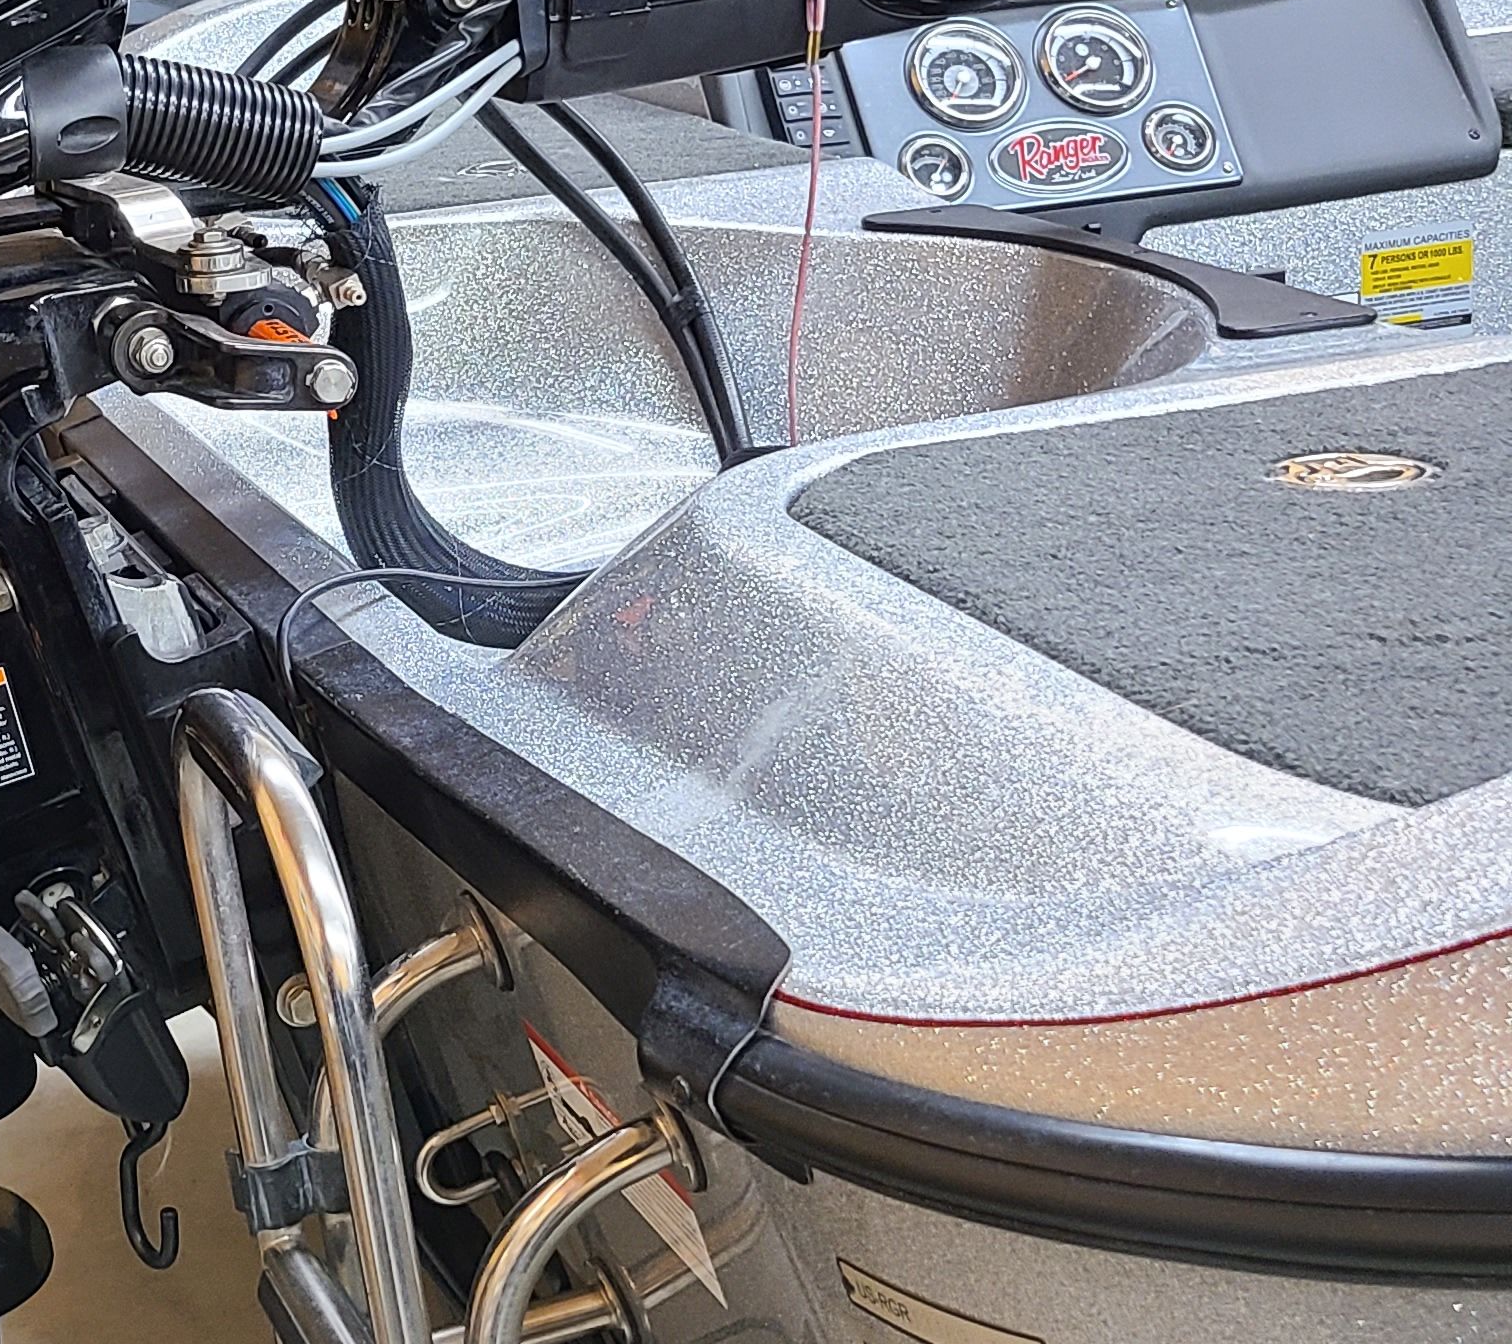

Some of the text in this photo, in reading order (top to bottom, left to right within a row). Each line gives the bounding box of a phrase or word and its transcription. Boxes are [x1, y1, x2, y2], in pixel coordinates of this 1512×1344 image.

[1008, 133, 1105, 182] Ranger
[1364, 229, 1471, 251] MAXIMUM CAPACITIES
[1368, 253, 1378, 270] 7
[1381, 252, 1416, 265] PERSONS
[1418, 250, 1429, 260] OR
